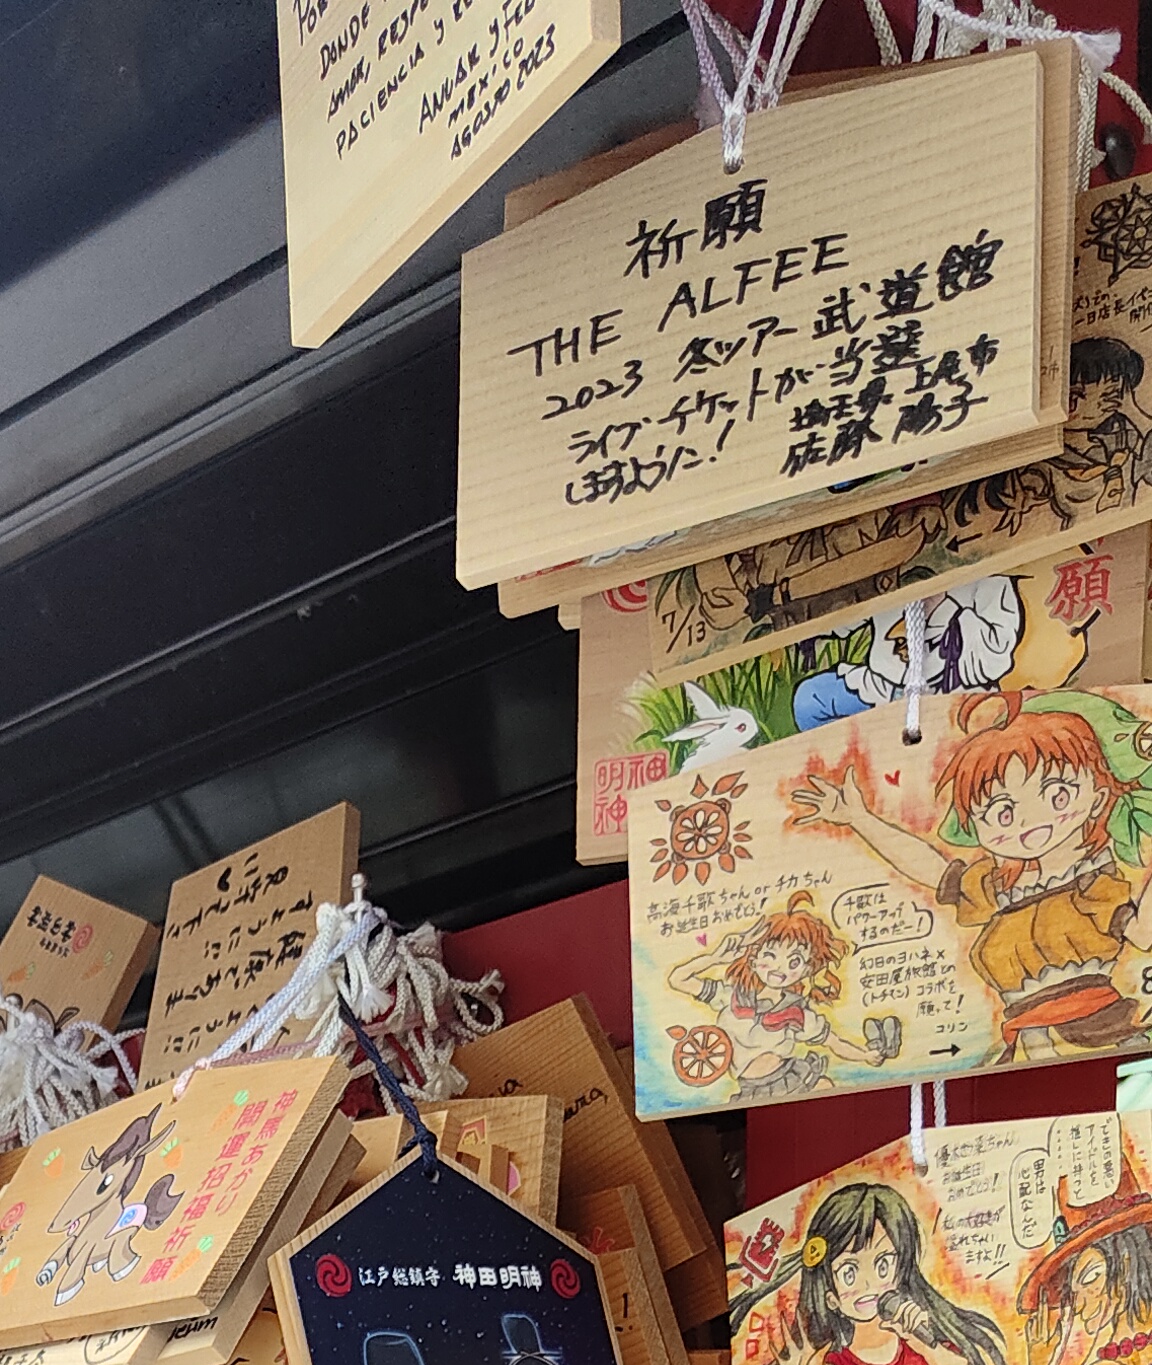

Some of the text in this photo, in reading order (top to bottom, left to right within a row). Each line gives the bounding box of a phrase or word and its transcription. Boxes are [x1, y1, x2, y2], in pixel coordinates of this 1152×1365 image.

[516, 23, 556, 90] 2023
[623, 179, 767, 279] 祈願
[508, 233, 850, 376] THE ALFEE
[541, 359, 645, 421] 2023
[812, 229, 1004, 340] 武道館
[659, 608, 707, 654] 7/13
[138, 1100, 269, 1286] 開運招福祈願
[358, 1261, 543, 1293] 江戸総鎮守 神田明神
